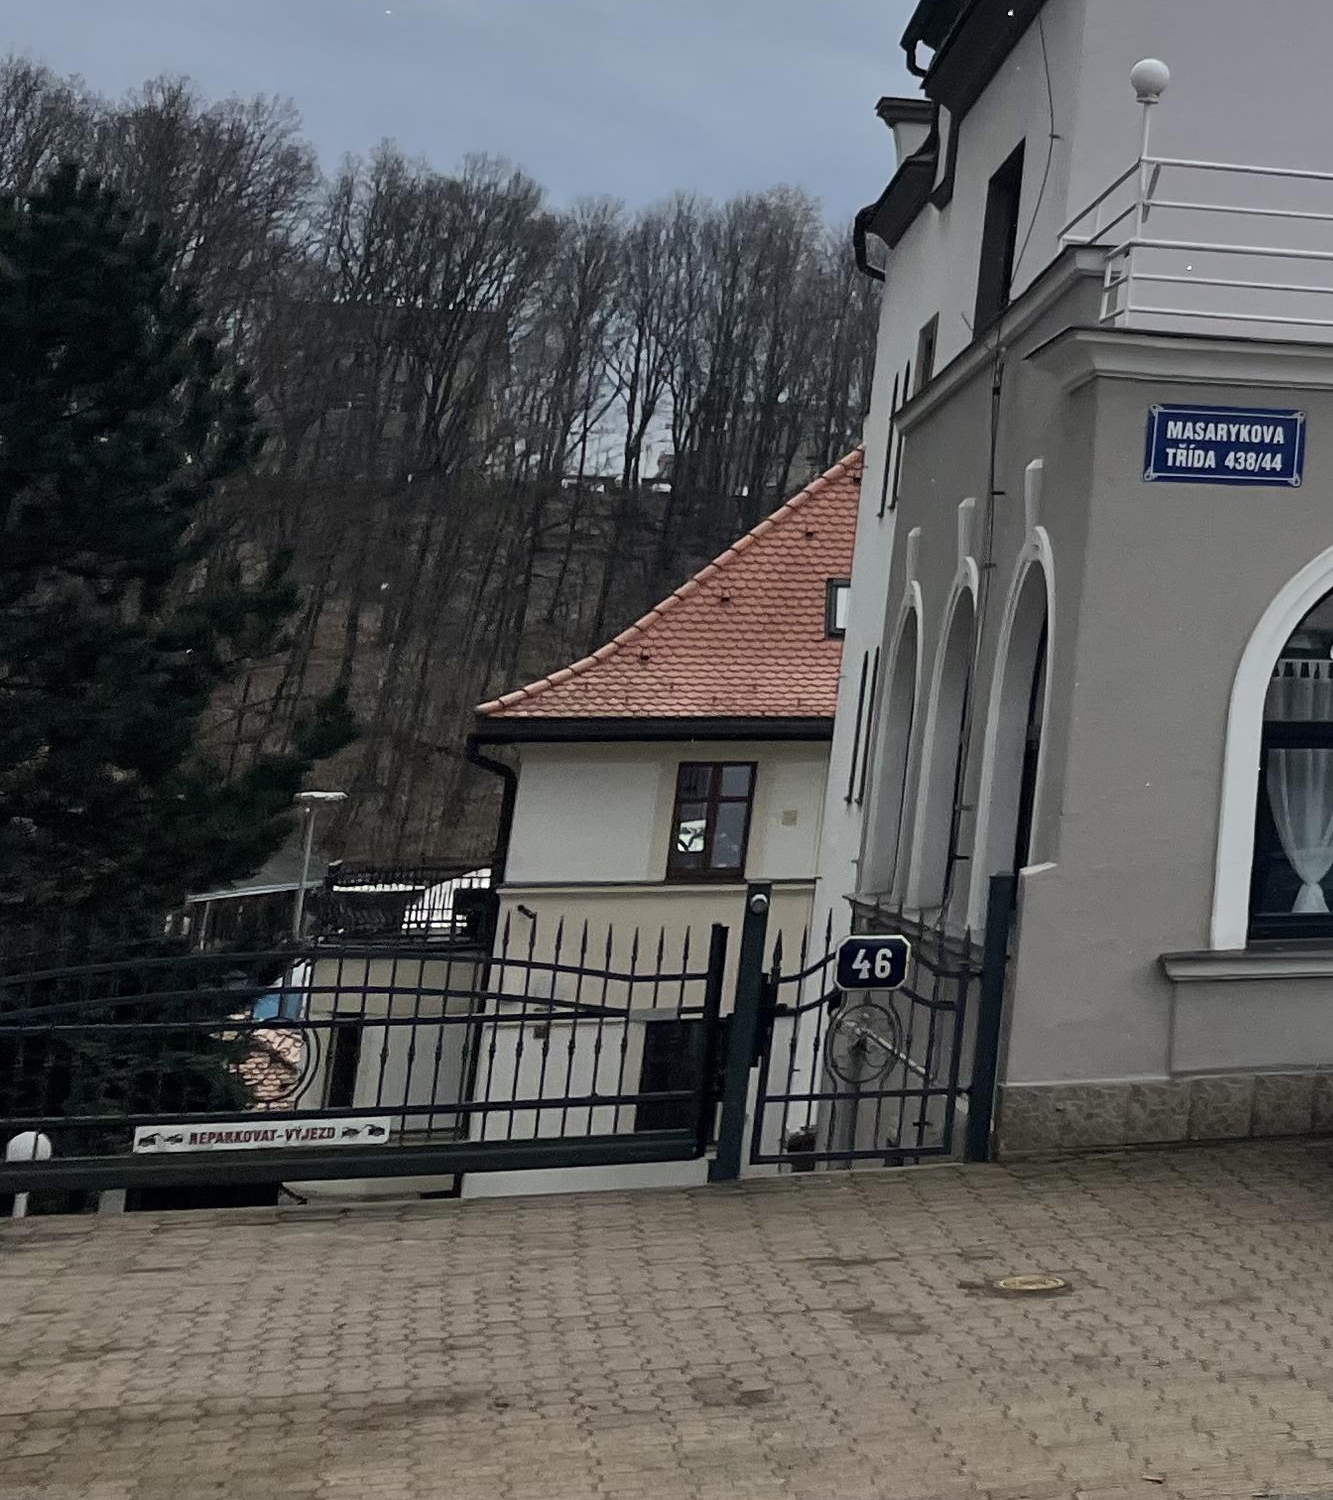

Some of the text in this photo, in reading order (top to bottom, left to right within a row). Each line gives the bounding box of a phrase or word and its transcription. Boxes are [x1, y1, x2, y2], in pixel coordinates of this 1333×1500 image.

[1166, 420, 1285, 444] MASARYKOVA
[1165, 443, 1282, 472] TŘÍDA 438/44
[851, 948, 893, 979] 46
